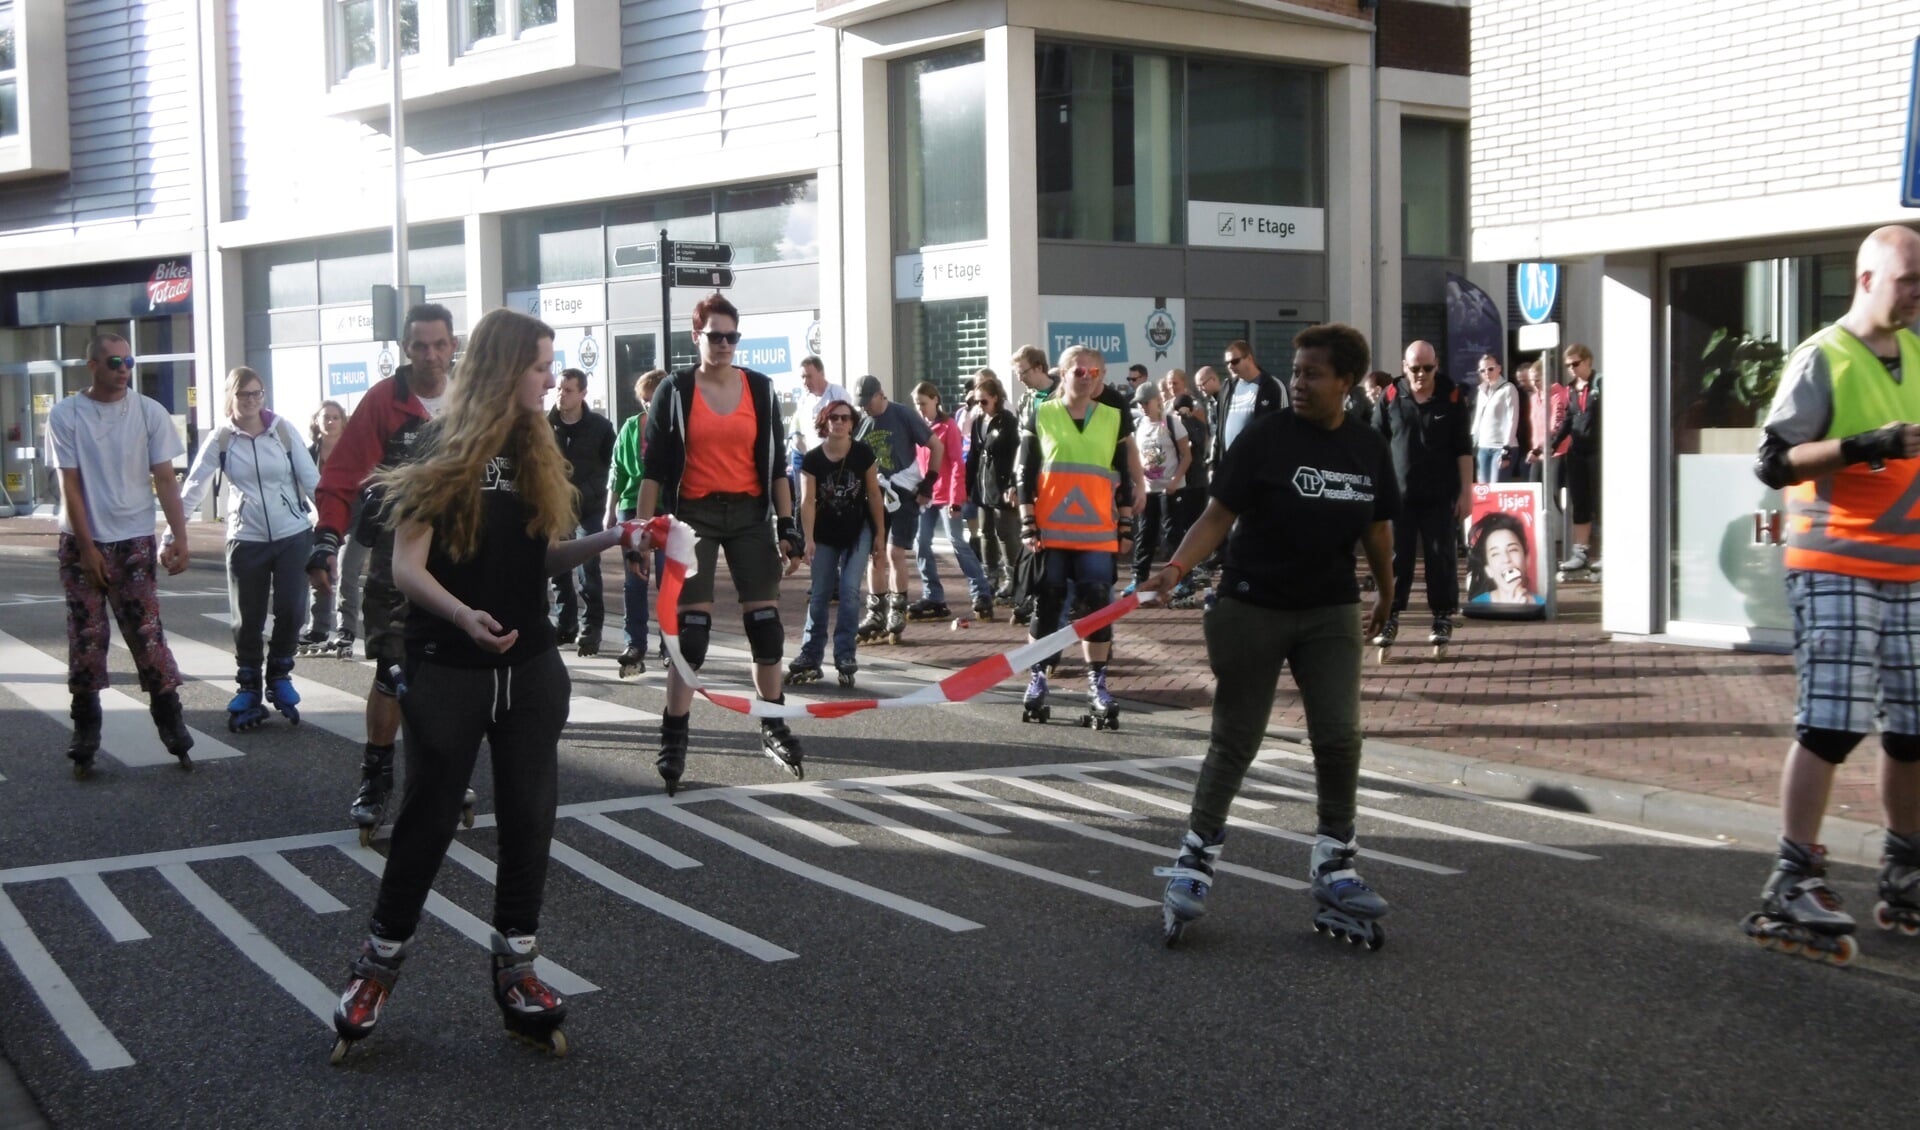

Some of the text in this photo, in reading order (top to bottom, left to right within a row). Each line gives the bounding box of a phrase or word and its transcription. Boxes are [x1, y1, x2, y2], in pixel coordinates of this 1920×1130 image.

[1258, 217, 1296, 238] Etage
[155, 261, 187, 280] Bike
[947, 263, 981, 281] Etage
[149, 278, 190, 311] Totaal
[555, 298, 583, 314] Etage
[1078, 335, 1121, 352] HUUR
[734, 347, 786, 365] TE HUUR
[330, 370, 366, 385] TE HUUR
[1299, 473, 1320, 491] TP
